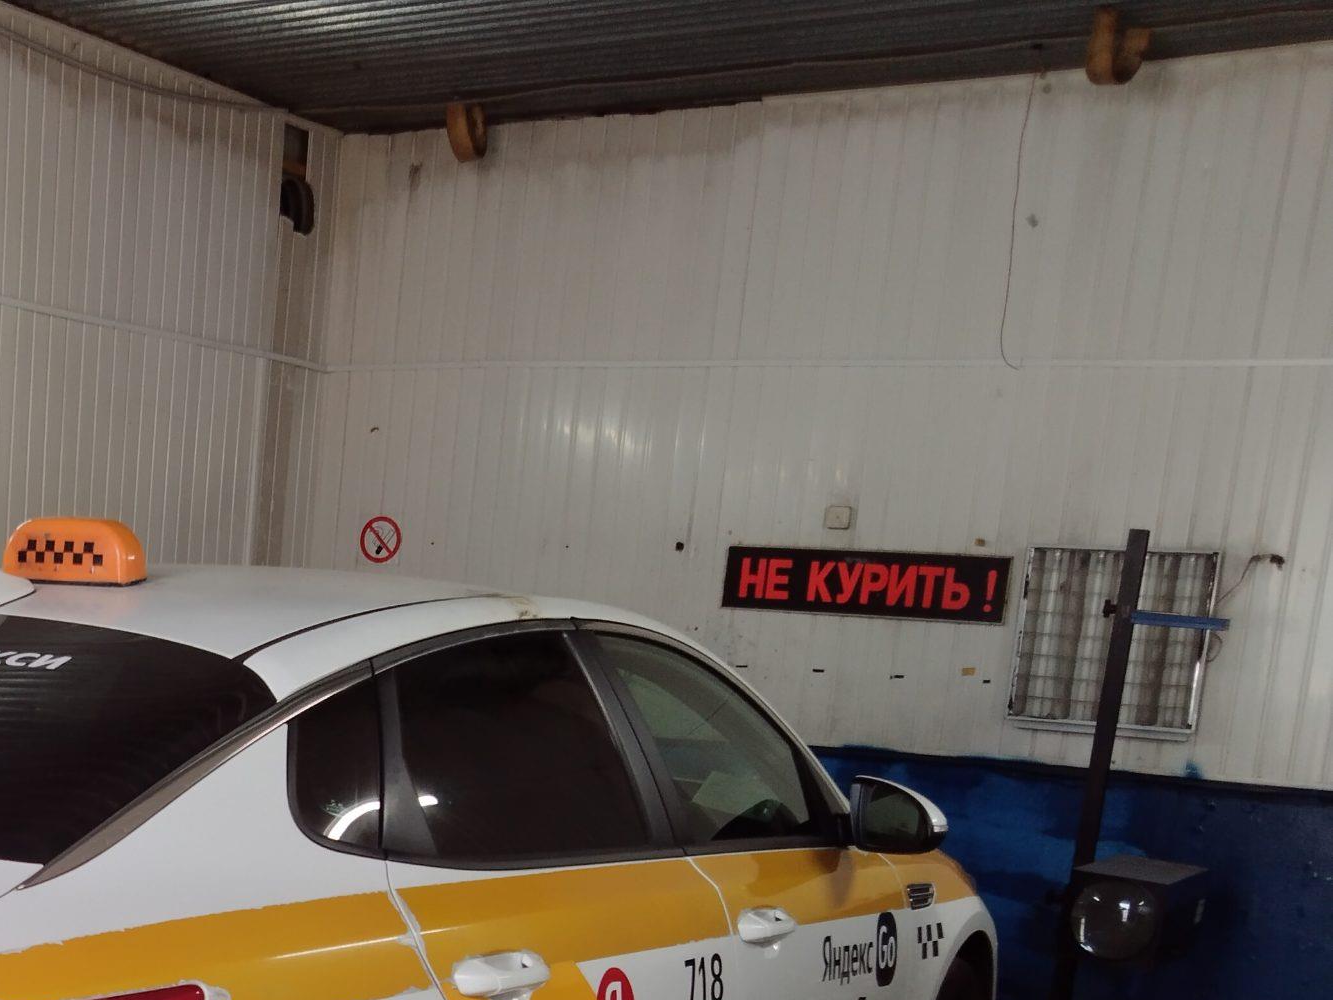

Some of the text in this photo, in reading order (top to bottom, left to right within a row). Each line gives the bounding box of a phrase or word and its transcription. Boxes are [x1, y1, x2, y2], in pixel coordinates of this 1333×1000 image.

[738, 556, 794, 600] НЕ
[806, 560, 971, 611] КУРИТЬ
[822, 924, 896, 986] Яндекс Go
